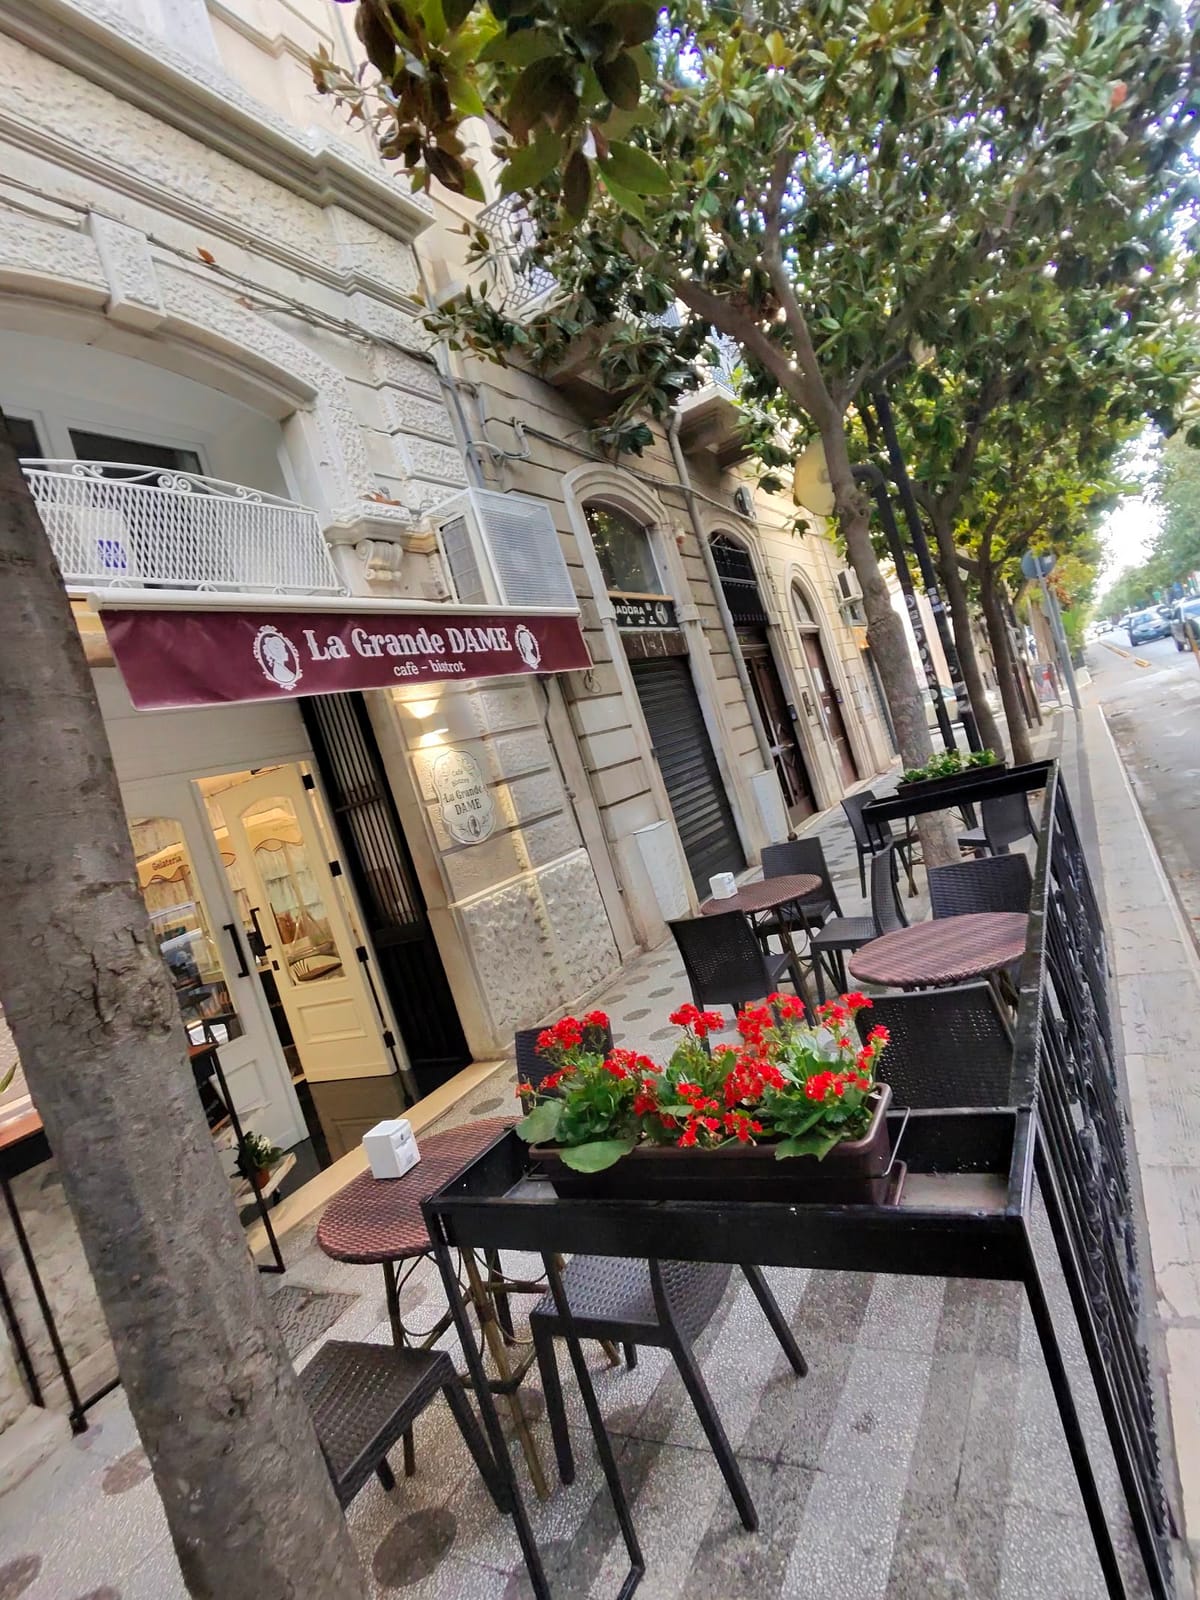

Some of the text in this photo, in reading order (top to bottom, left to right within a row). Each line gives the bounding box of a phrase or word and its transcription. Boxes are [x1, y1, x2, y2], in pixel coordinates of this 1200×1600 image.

[302, 627, 513, 661] La Grande DAME
[430, 659, 466, 673] bistrot
[444, 785, 482, 803] La Grande
[455, 798, 481, 815] DAME
[151, 854, 182, 871] Gelateria
